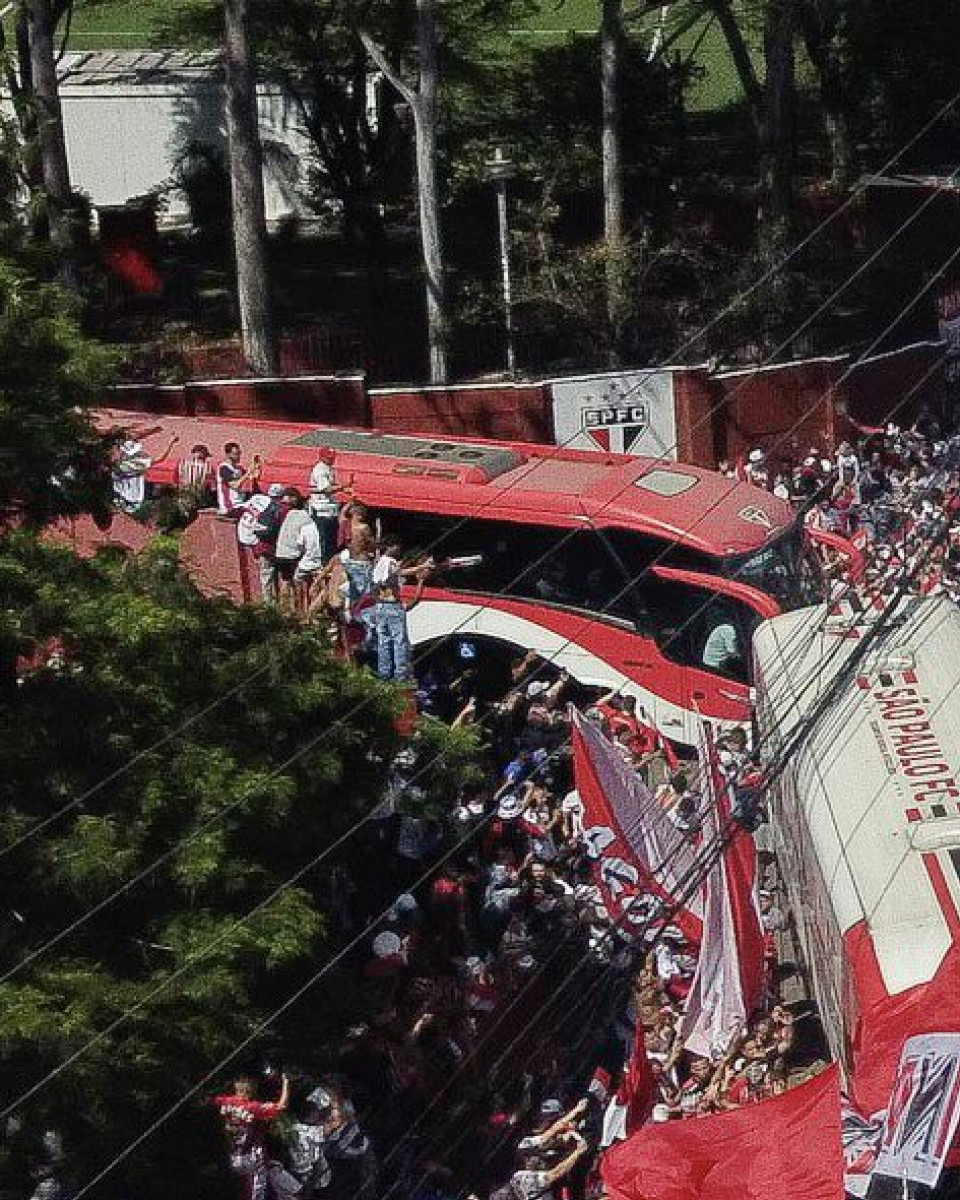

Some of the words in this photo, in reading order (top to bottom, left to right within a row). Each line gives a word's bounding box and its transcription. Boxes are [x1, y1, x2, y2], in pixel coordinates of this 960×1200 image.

[587, 407, 645, 425] SPFC
[873, 688, 931, 720] SÃO
[887, 720, 950, 776] PAULO
[909, 778, 960, 801] FC
